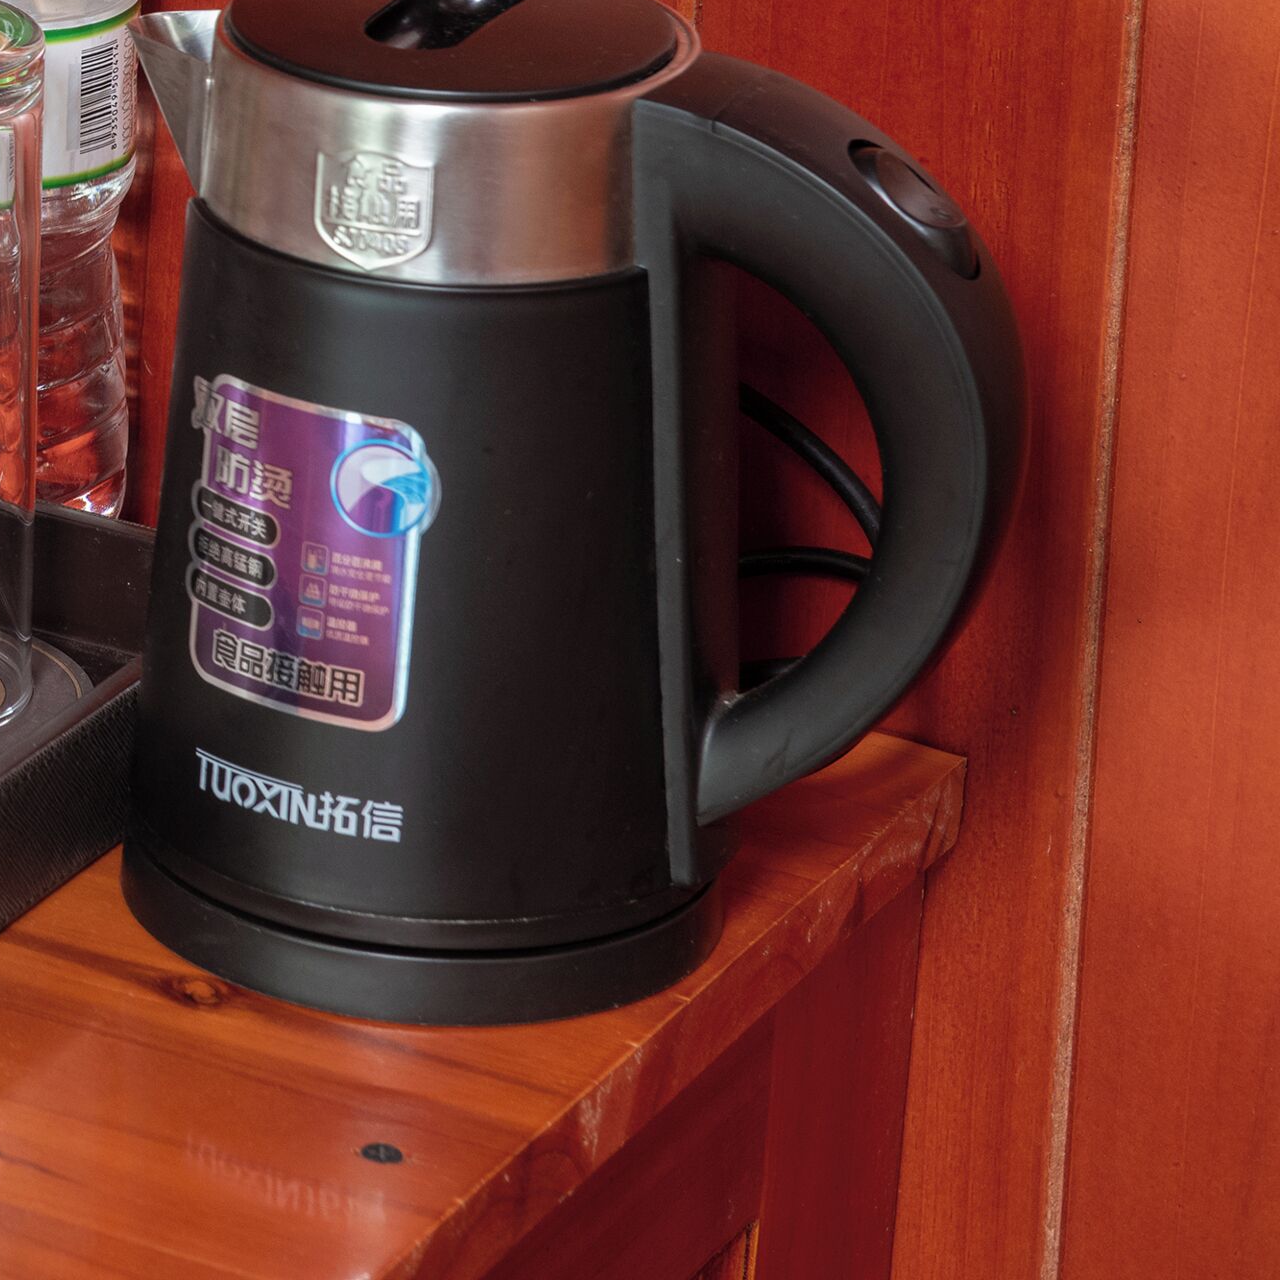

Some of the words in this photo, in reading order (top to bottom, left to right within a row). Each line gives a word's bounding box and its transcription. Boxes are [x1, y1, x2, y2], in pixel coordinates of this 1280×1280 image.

[215, 444, 293, 510] 防烫
[212, 627, 365, 708] 食品接触用
